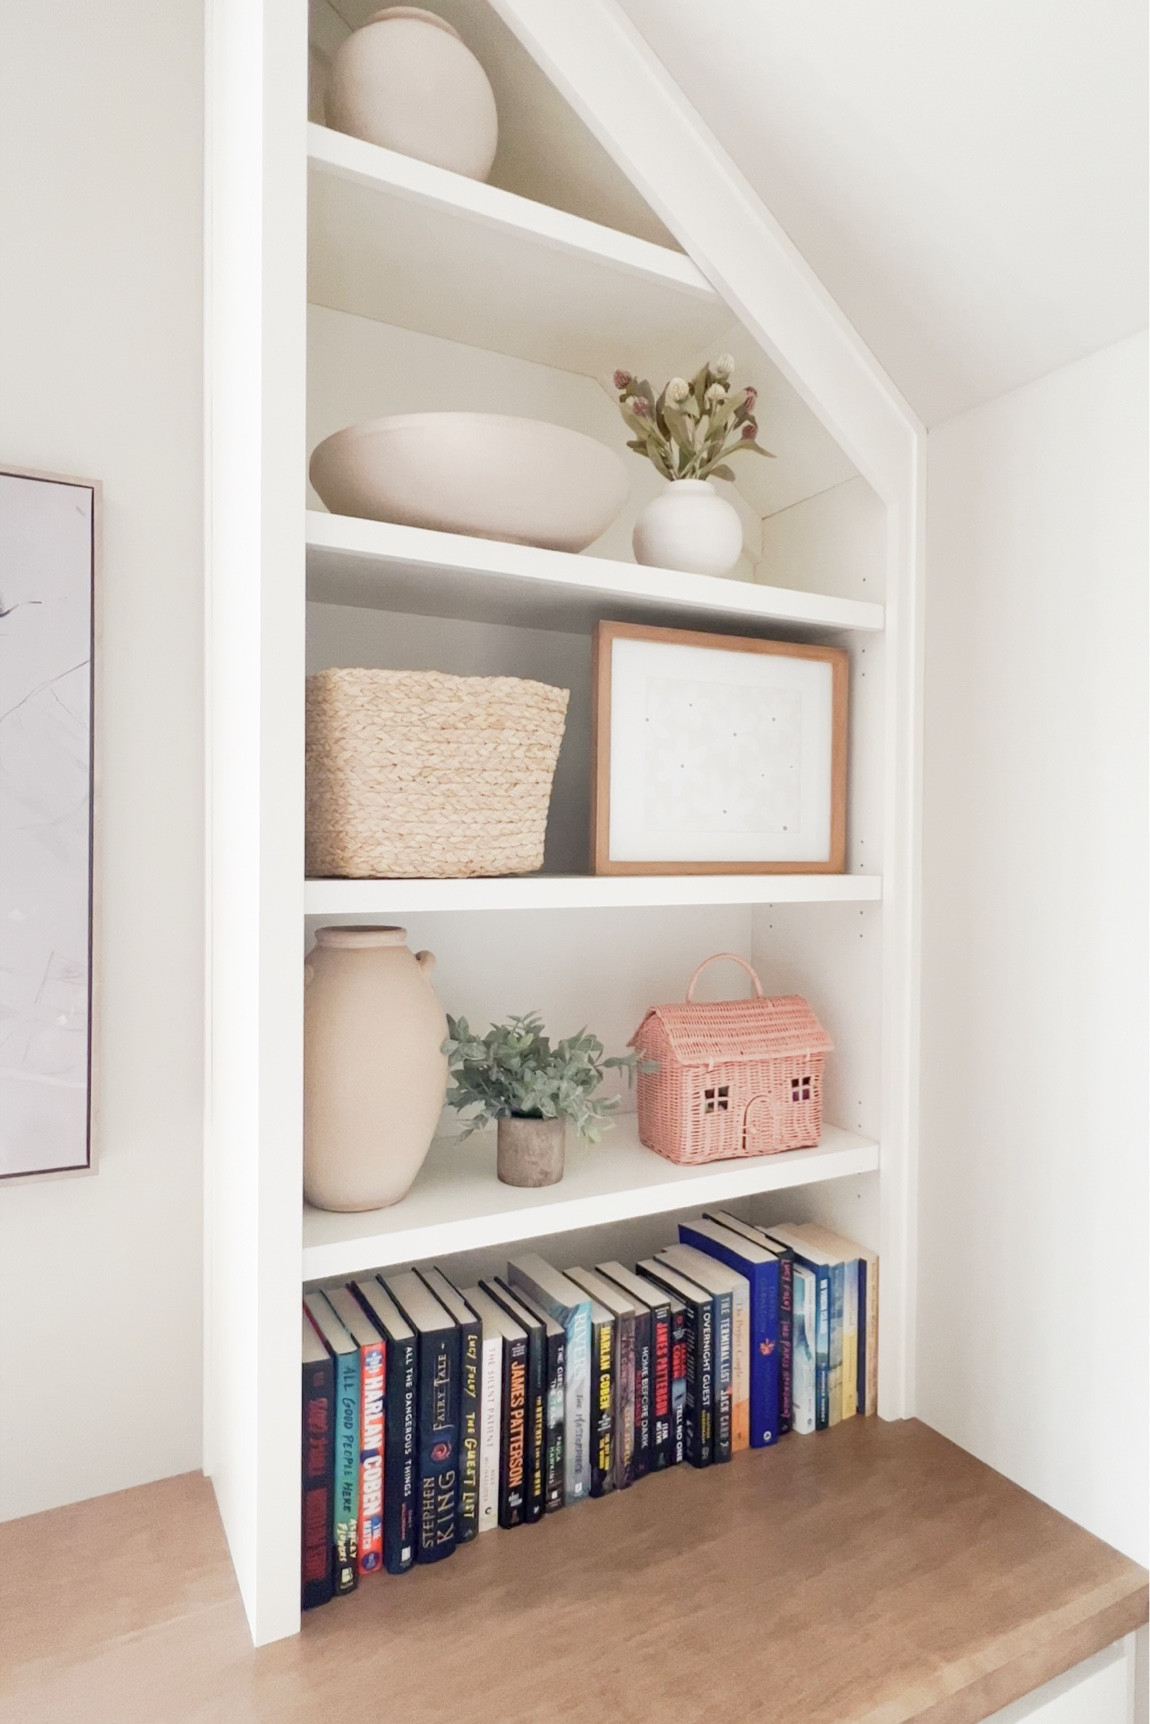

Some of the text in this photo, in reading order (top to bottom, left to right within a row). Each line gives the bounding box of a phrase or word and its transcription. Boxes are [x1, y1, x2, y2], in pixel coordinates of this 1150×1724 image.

[781, 1259, 791, 1282] LUCY
[780, 1284, 791, 1311] FOLEY
[574, 1311, 588, 1379] RIVERS
[599, 1326, 611, 1371] HARLAN
[656, 1322, 668, 1355] JAMES
[702, 1313, 712, 1373] OVERNIGHT
[781, 1321, 790, 1337] THE
[405, 1346, 413, 1365] ALL
[672, 1344, 681, 1379] COBEN
[720, 1296, 731, 1440] THE TERMINAL LIST JACK CARR
[780, 1340, 791, 1368] PARIS
[405, 1367, 413, 1387] THE
[433, 1354, 455, 1431] FAIRY TALE
[485, 1347, 496, 1448] THE SILENT PATIENT
[510, 1361, 525, 1407] JAMES
[556, 1366, 565, 1389] GIRL
[599, 1373, 610, 1410] COBEN
[640, 1346, 649, 1450] HOME BEFORE DARK
[655, 1357, 668, 1416] PATTERSON
[702, 1374, 711, 1406] GUEST
[342, 1367, 356, 1513] ALL GOOD PEOPLE HERE
[362, 1375, 384, 1516] HARLAN COBEN
[404, 1392, 413, 1455] DANGEROUS
[462, 1334, 478, 1519] LUCY FOLEY THE GUEST LIST
[508, 1408, 524, 1487] PATTERSON
[623, 1431, 632, 1467] JEWELL
[404, 1459, 412, 1497] THINGS
[422, 1477, 435, 1549] STEPHEN
[437, 1470, 456, 1545] KING
[337, 1523, 348, 1562] FLOWERS
[348, 1519, 358, 1558] ASHLEY
